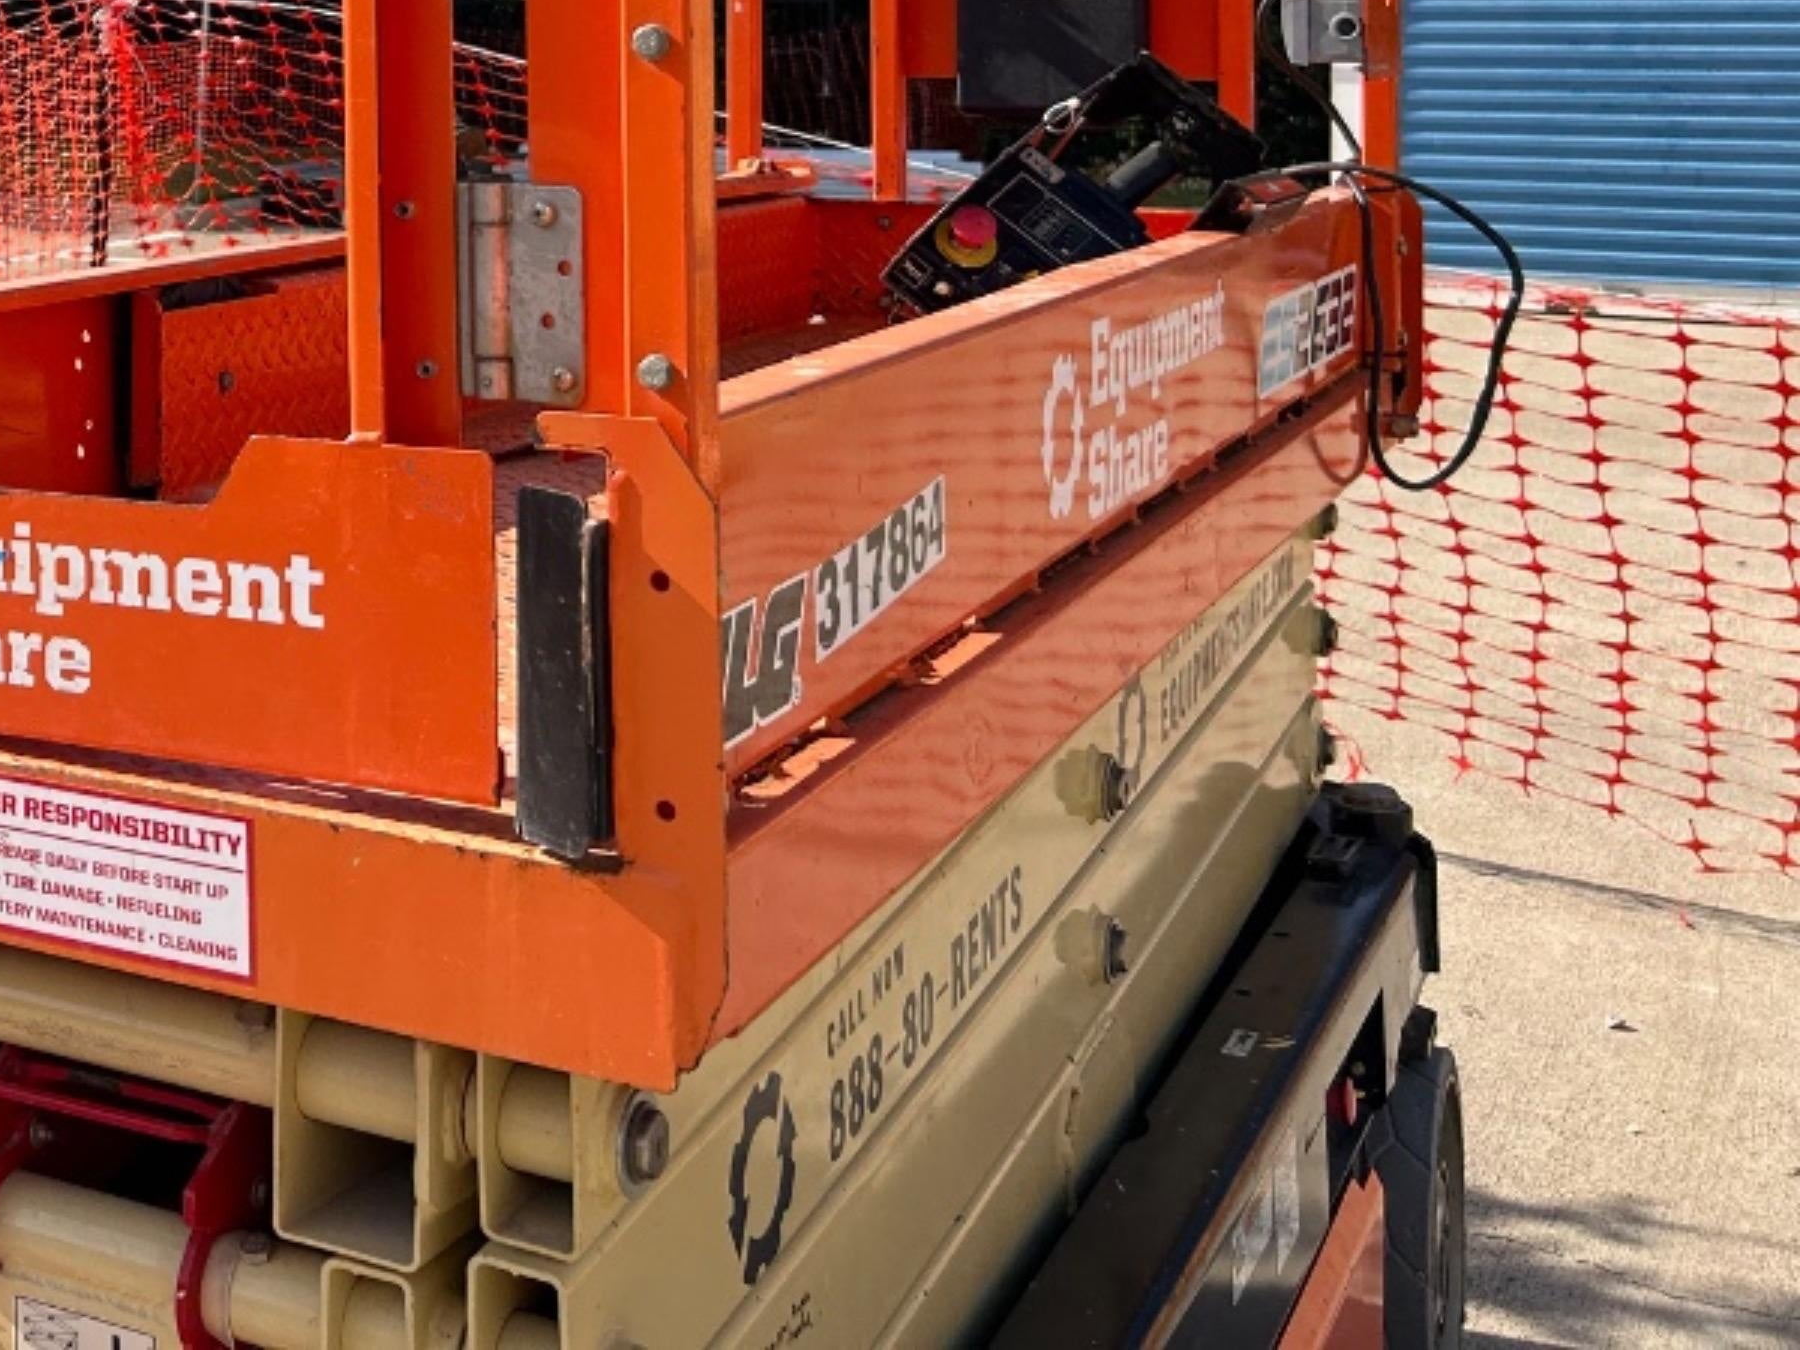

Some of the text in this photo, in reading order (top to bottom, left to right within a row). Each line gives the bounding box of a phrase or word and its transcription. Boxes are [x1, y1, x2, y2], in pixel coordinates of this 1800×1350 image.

[1088, 278, 1225, 418] Equipment
[1087, 419, 1169, 520] Share
[817, 479, 943, 650] 317864
[24, 796, 241, 857] RESPONSIBILITY
[44, 851, 88, 873] DAILY
[92, 860, 151, 886] BEFORE
[153, 872, 203, 896] START
[206, 884, 229, 900] UP
[3, 872, 37, 891] TIRE
[41, 879, 105, 907] DAMAGE
[116, 893, 203, 926] REFUELING
[35, 906, 145, 943] MAINTENANCE
[158, 932, 238, 962] CLEANING
[827, 941, 905, 1060] CALL NOW
[829, 864, 1023, 1163] 888-80-RENTS
